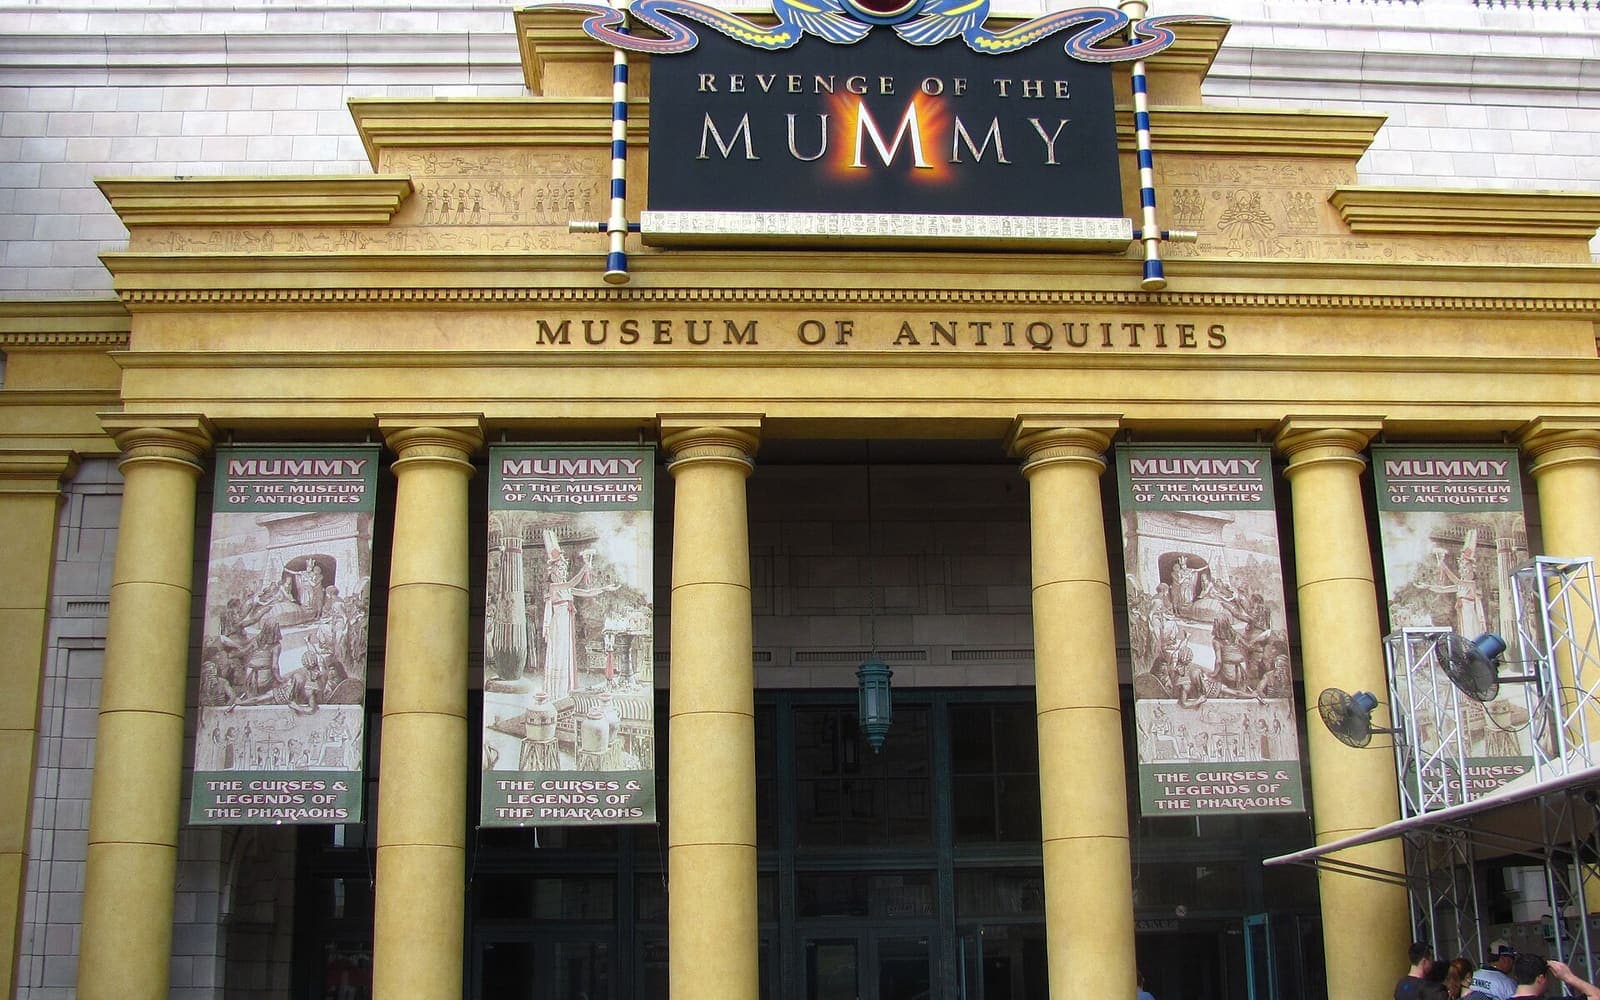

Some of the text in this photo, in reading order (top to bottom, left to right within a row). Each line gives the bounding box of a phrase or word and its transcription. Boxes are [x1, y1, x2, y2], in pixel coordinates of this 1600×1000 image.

[697, 73, 1071, 99] REVENGE OF THE
[695, 100, 1072, 169] MUMMY
[535, 320, 1227, 350] MUSEUM OF ANTIQUITIES
[228, 459, 367, 476] MUMMY
[502, 458, 643, 475] MUMMY
[1129, 458, 1261, 475] MUMMY
[1385, 460, 1508, 477] MUMMY
[227, 485, 365, 493] AT THE MUSEUM
[501, 484, 643, 492] AT THE MUSEUM
[1131, 484, 1263, 492] AT THE MUSEUM
[1387, 485, 1511, 494] AT THE MUSEUM
[229, 495, 360, 505] OF ANTIQUITIES
[504, 494, 638, 504] OF ANTIQUITIES
[1135, 494, 1261, 504] OF ANTIQUITIES
[1391, 495, 1509, 505] OF ANTIQUITIES
[1154, 770, 1289, 784] THE CURSES &
[207, 781, 349, 793] THE CURSES &
[496, 780, 641, 793] THE CURSES &
[1165, 784, 1281, 796] LEGENDS OF
[216, 794, 337, 804] LEGENDS OF
[507, 794, 631, 804] LEGENDS OF
[1154, 797, 1292, 810] THE PHARAOHS
[204, 808, 349, 820] THE PHARAOHS
[495, 807, 643, 821] THE PHARAOHS
